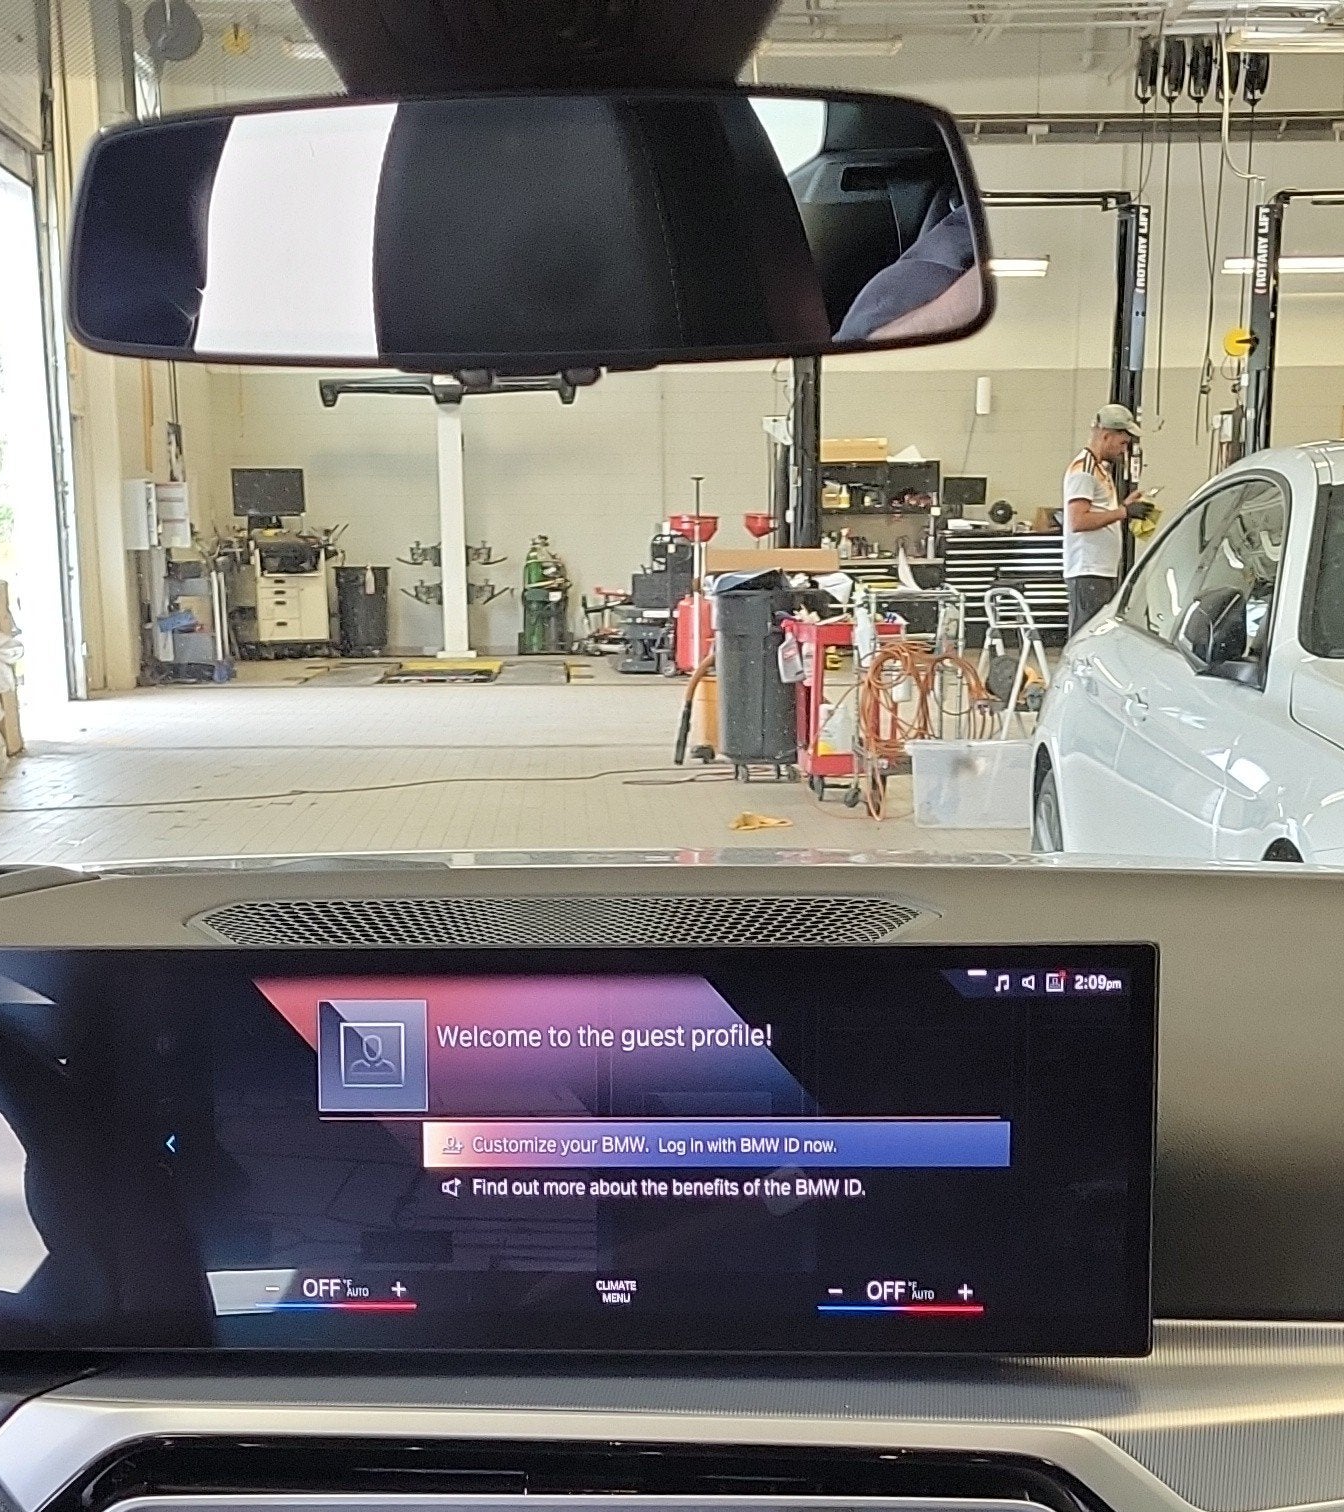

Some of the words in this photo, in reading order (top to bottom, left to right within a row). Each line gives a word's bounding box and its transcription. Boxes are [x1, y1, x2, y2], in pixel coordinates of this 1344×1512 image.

[1138, 206, 1149, 234] LIFT
[1258, 206, 1271, 234] LIFT
[1136, 235, 1148, 288] ROTARY
[1255, 236, 1269, 288] ROTARY
[1074, 974, 1123, 991] 2:09pm
[436, 1025, 542, 1048] Welcome
[547, 1027, 572, 1048] to
[577, 1025, 615, 1048] the
[621, 1027, 686, 1052] guest
[691, 1024, 773, 1052] profile!
[472, 1136, 557, 1154] Customize
[560, 1139, 598, 1157] your
[601, 1135, 651, 1154] BMW.
[658, 1137, 687, 1156] Log
[707, 1137, 737, 1154] with
[740, 1137, 780, 1154] BMW
[784, 1137, 800, 1154] ID
[803, 1140, 838, 1154] now.
[472, 1177, 508, 1196] Find
[511, 1179, 540, 1196] out
[543, 1181, 586, 1196] more
[590, 1178, 638, 1196] about
[641, 1178, 668, 1196] the
[672, 1178, 740, 1196] benefits
[743, 1178, 761, 1196] of
[764, 1178, 792, 1196] the
[795, 1178, 840, 1196] BMW
[844, 1178, 867, 1196] ID.
[302, 1278, 342, 1298] OFF
[346, 1287, 370, 1297] AUTO
[595, 1280, 638, 1292] CLIMATE
[866, 1280, 907, 1301] OFF
[912, 1290, 936, 1300] AUTO
[602, 1292, 632, 1304] MENU
